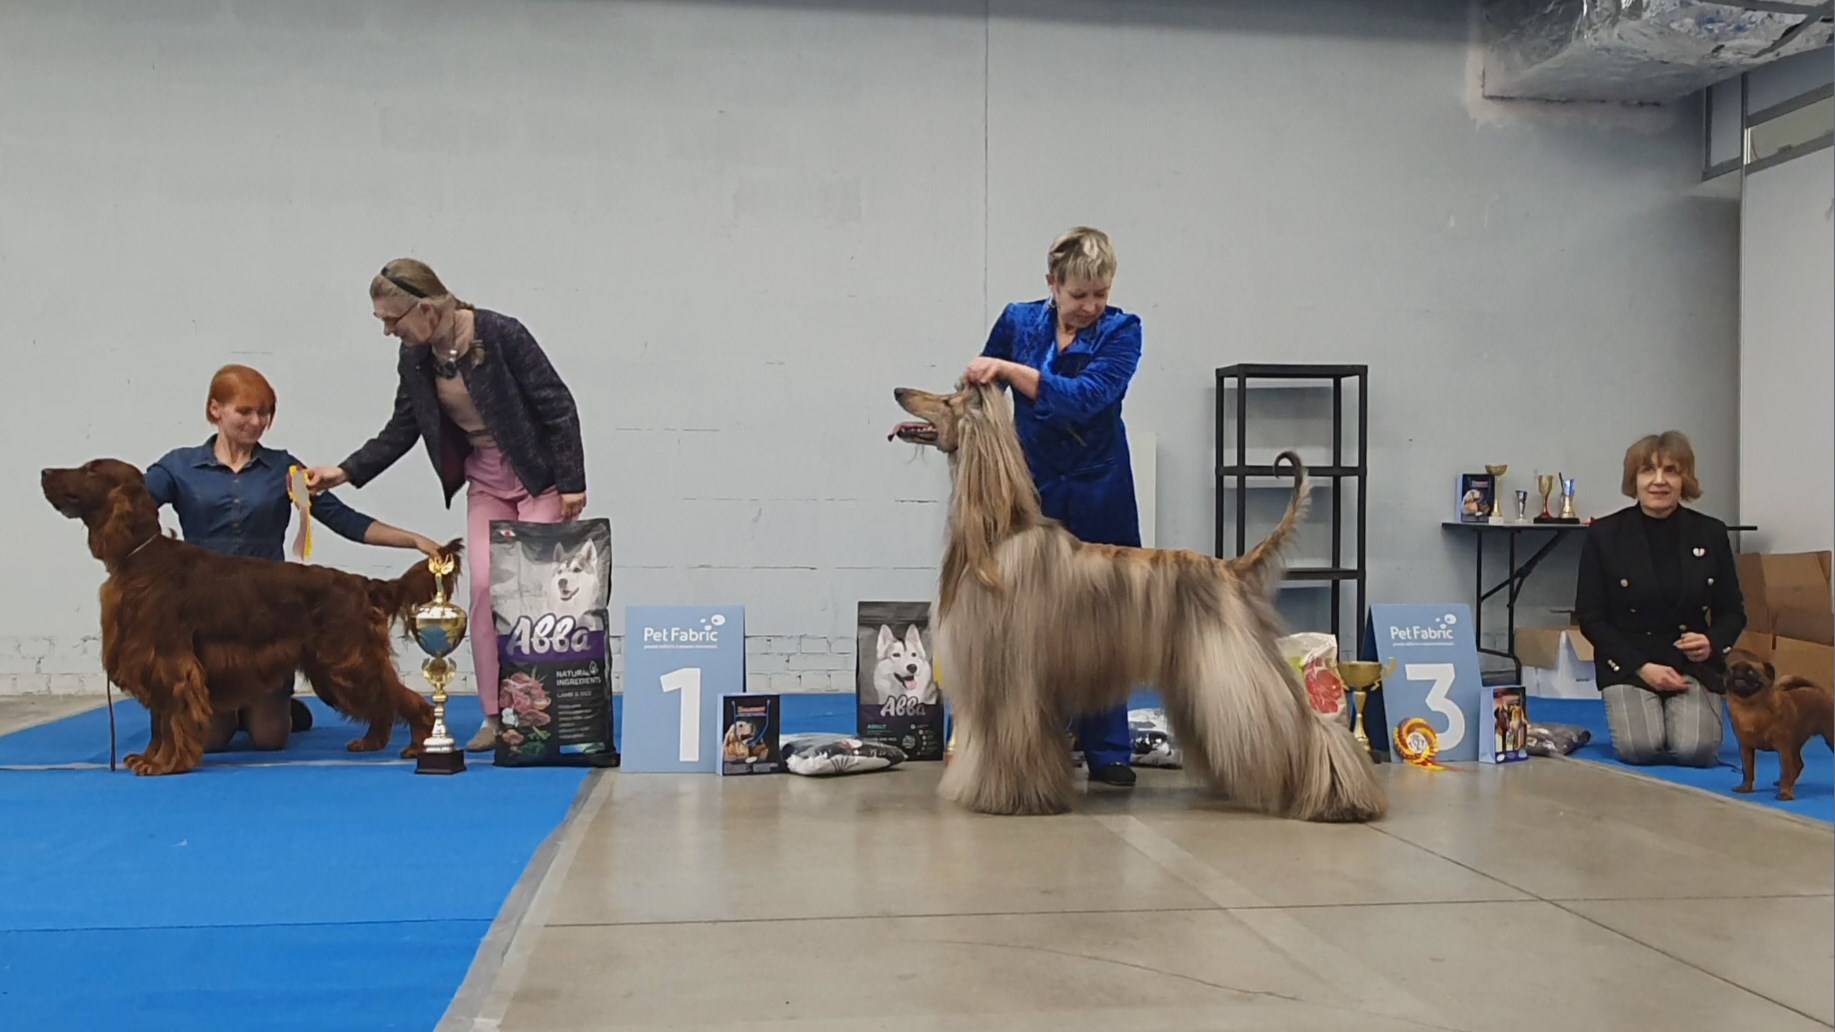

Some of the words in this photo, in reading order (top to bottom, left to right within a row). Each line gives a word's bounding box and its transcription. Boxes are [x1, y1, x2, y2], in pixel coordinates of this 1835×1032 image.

[644, 627, 668, 641] Pet
[671, 626, 718, 641] Fabric
[1390, 626, 1411, 640] Pet
[1412, 626, 1454, 640] Fabric
[556, 669, 590, 678] NATURAL
[660, 667, 701, 762] 1
[1405, 663, 1465, 751] 3
